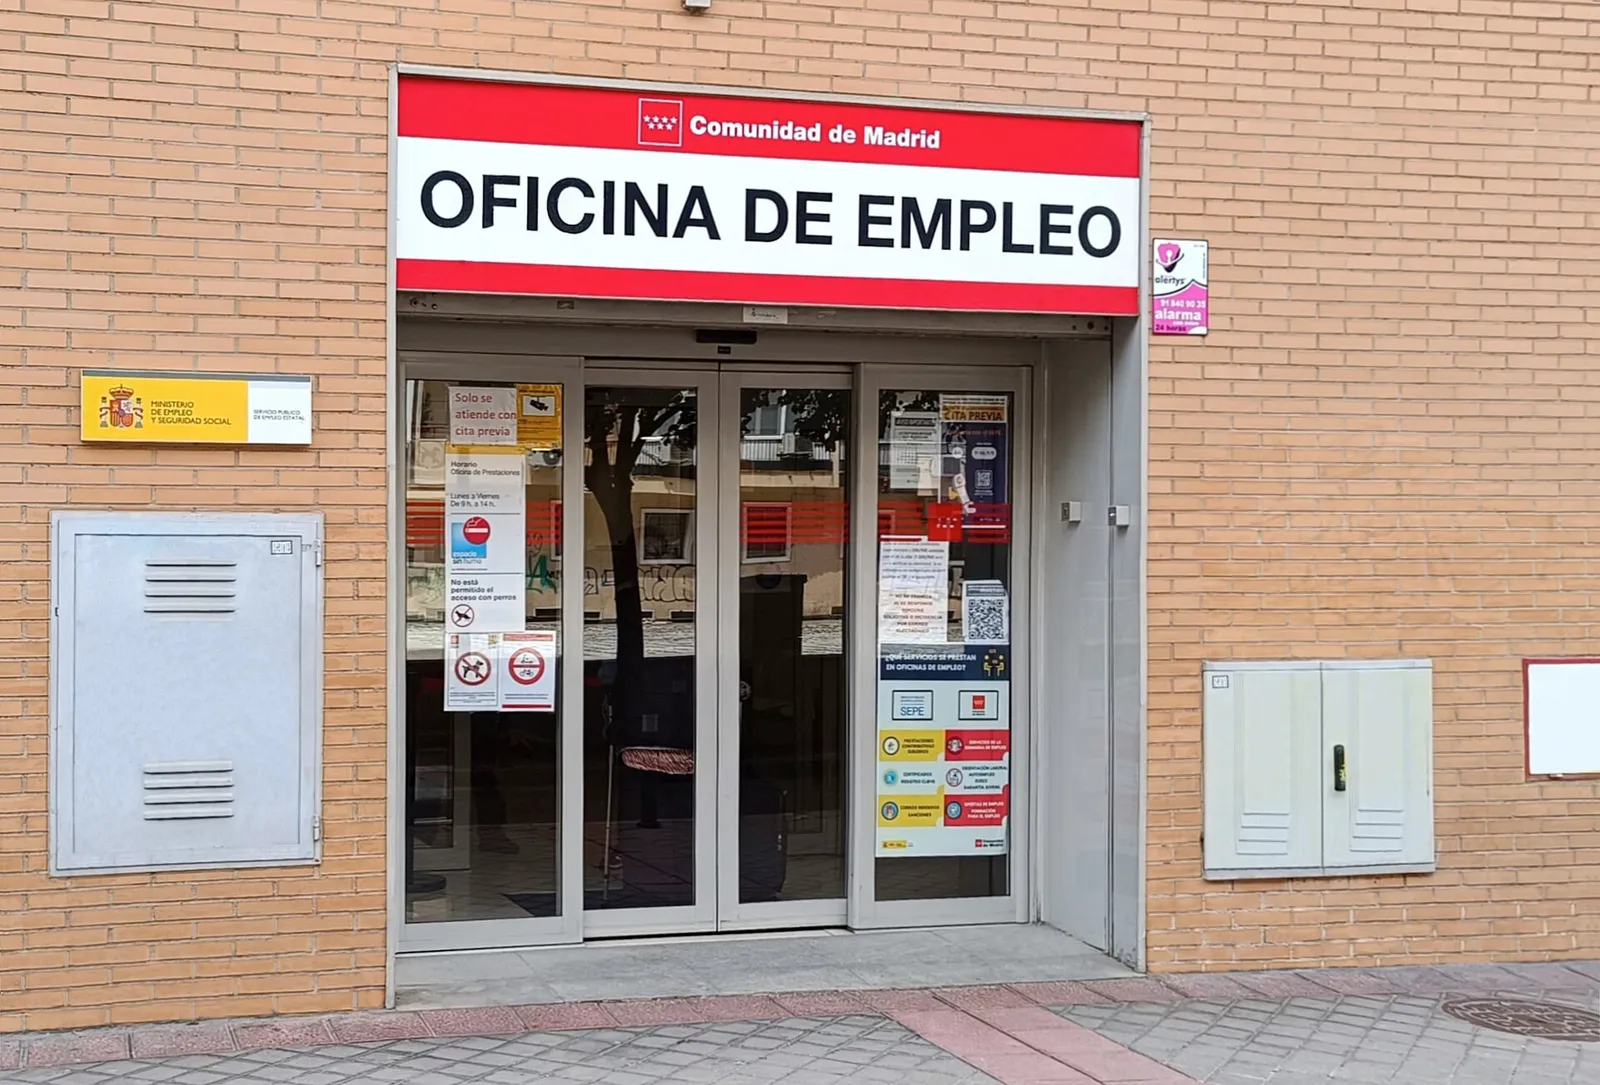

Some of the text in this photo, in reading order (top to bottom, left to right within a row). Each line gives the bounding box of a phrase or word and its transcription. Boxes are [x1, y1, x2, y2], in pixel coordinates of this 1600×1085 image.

[689, 114, 941, 150] Comunidad de Madrid
[420, 170, 1121, 258] OFICINA DE EMPLEO
[1154, 307, 1202, 321] alarma
[1166, 324, 1187, 332] horas
[455, 393, 493, 403] Solo se
[151, 408, 162, 416] DE
[455, 409, 517, 420] atiende con
[943, 410, 1003, 421] CITA PREVIA
[158, 417, 202, 425] SEGURIDAD
[203, 417, 232, 426] SOCIAL
[455, 426, 475, 436] cita
[478, 426, 511, 437] previa
[903, 653, 938, 661] SERVICIOS
[947, 653, 977, 661] PRESTAN
[900, 706, 925, 716] SEPE
